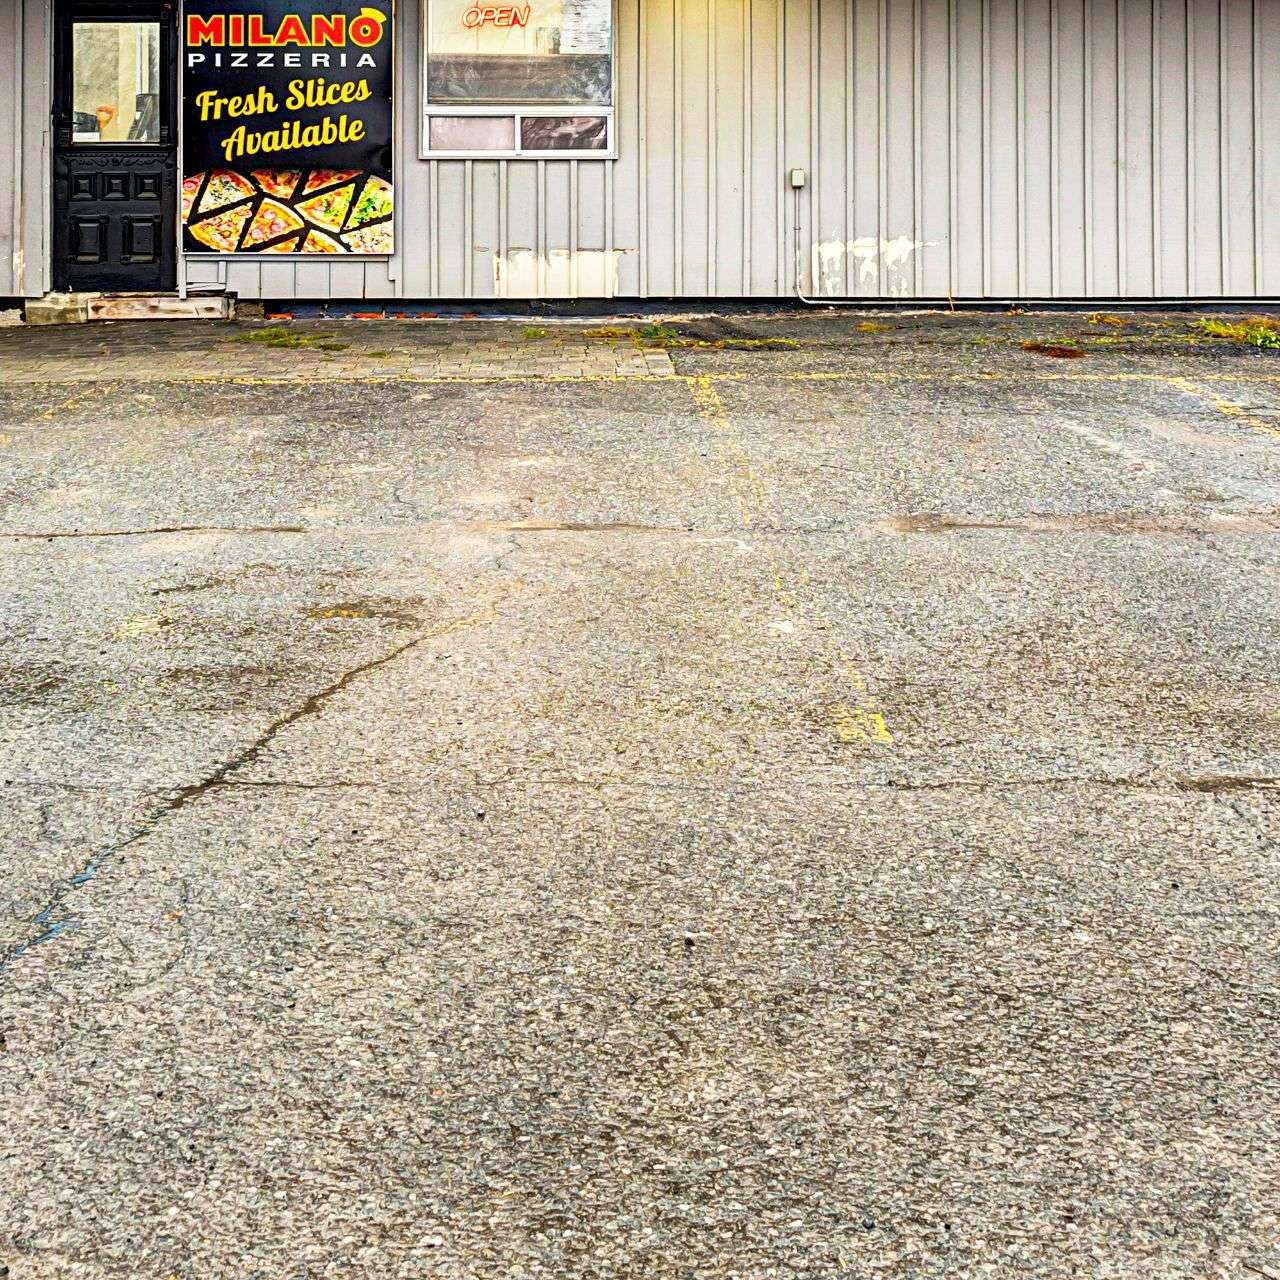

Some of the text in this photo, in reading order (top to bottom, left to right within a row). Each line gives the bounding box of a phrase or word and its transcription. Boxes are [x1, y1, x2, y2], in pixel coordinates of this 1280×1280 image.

[187, 8, 387, 47] MILANO
[462, 5, 531, 29] OPEN
[188, 53, 376, 68] PIZZERIA
[195, 78, 372, 121] Fresh Slices
[220, 115, 365, 161] Available
